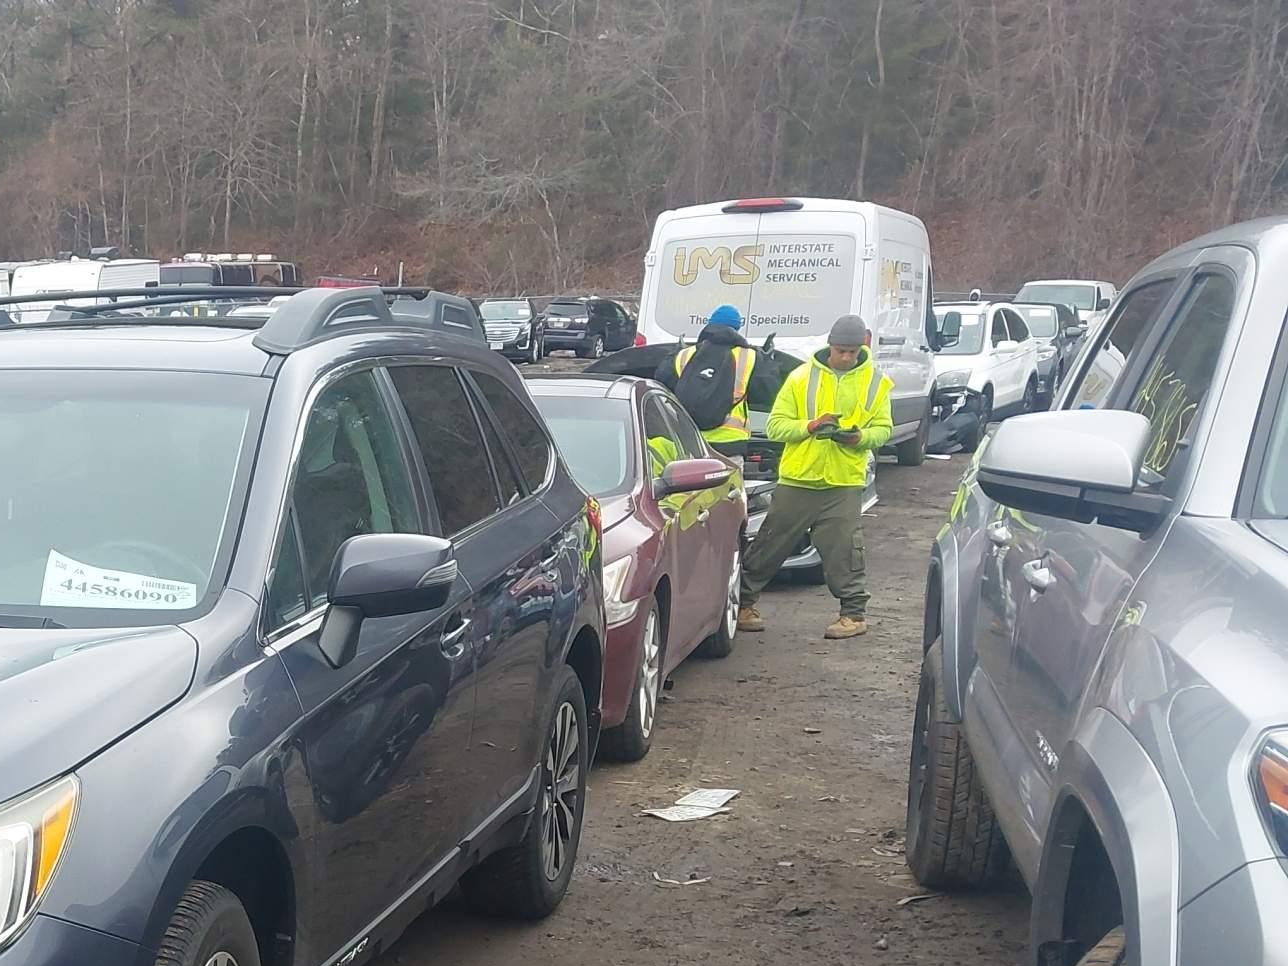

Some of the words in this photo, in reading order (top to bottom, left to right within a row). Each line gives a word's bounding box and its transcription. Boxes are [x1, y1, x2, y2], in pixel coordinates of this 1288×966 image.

[769, 243, 835, 254] INTERSTATE
[767, 258, 841, 268] MECHANICAL
[765, 272, 817, 283] SERVICES
[689, 315, 709, 325] The
[750, 314, 810, 327] Specialists
[59, 578, 178, 604] 44586090
